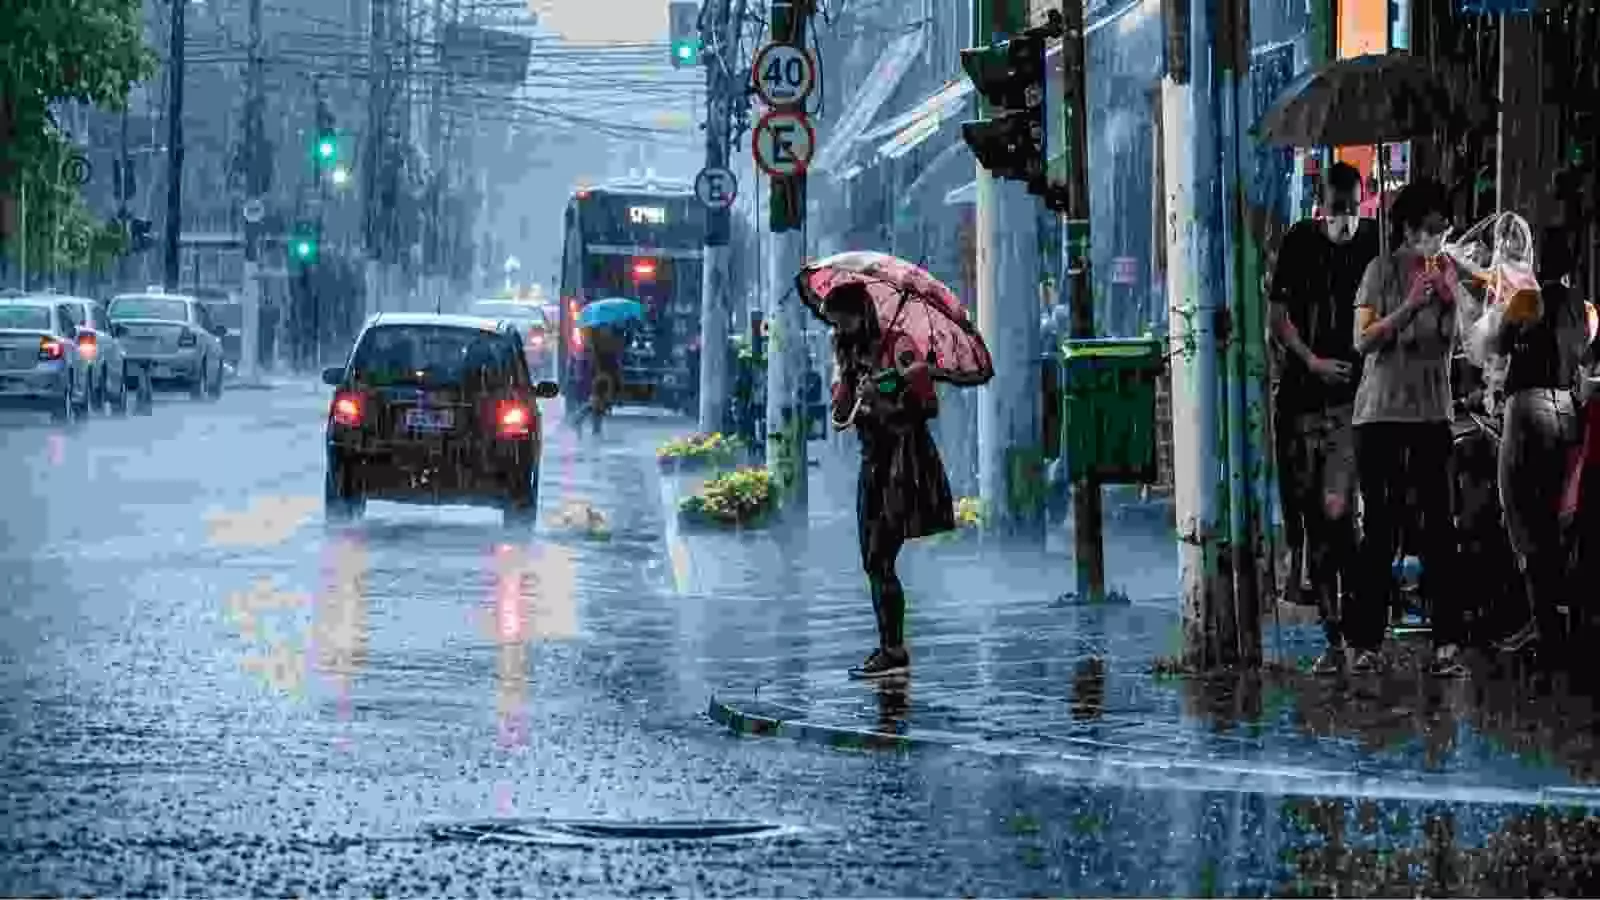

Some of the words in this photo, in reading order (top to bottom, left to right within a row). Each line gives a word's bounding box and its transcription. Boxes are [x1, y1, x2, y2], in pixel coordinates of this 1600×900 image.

[763, 57, 803, 87] 40
[772, 125, 795, 163] E
[708, 175, 724, 201] E
